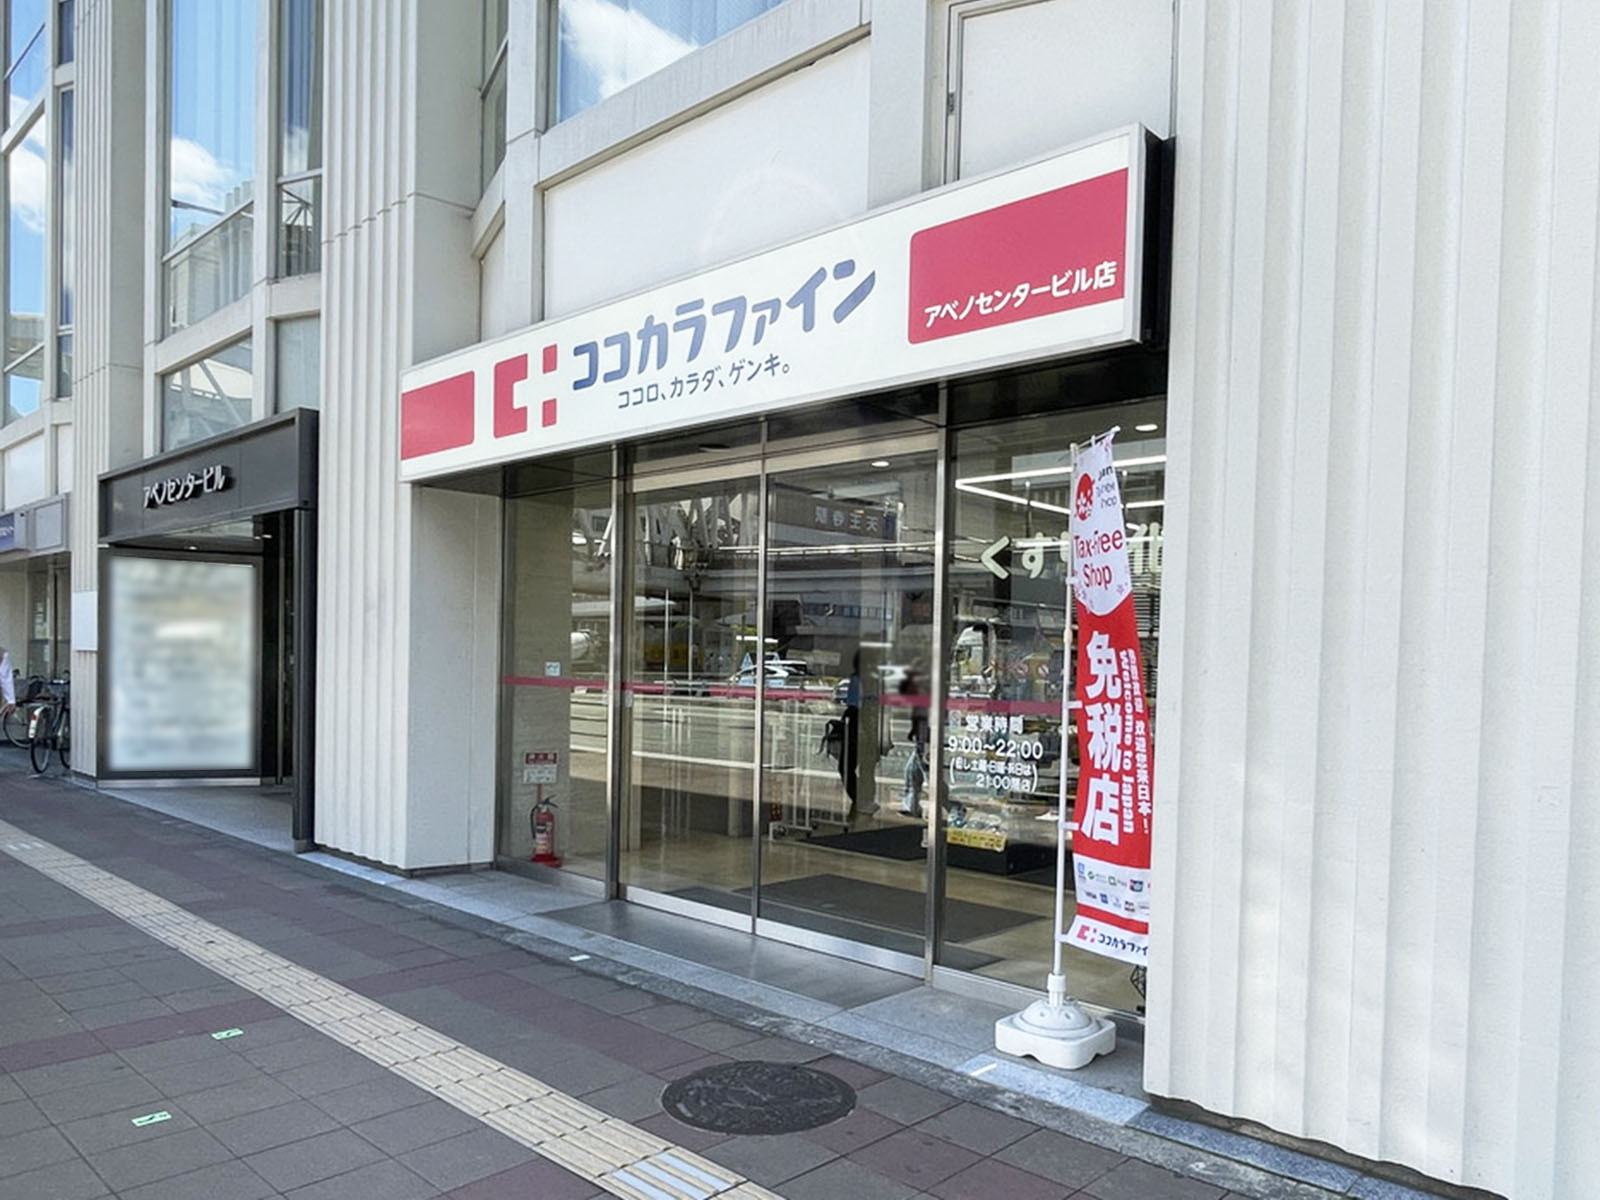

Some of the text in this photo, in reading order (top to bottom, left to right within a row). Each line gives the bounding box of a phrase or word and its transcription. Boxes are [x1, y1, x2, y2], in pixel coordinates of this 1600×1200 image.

[572, 259, 876, 391] ココカラファイン
[924, 260, 1118, 329] アベノセンタービル店
[617, 353, 790, 409] ココロ、カラダ、ゲンキ。
[1081, 630, 1122, 845] 免税店
[1119, 649, 1135, 834] Welcome to Japan
